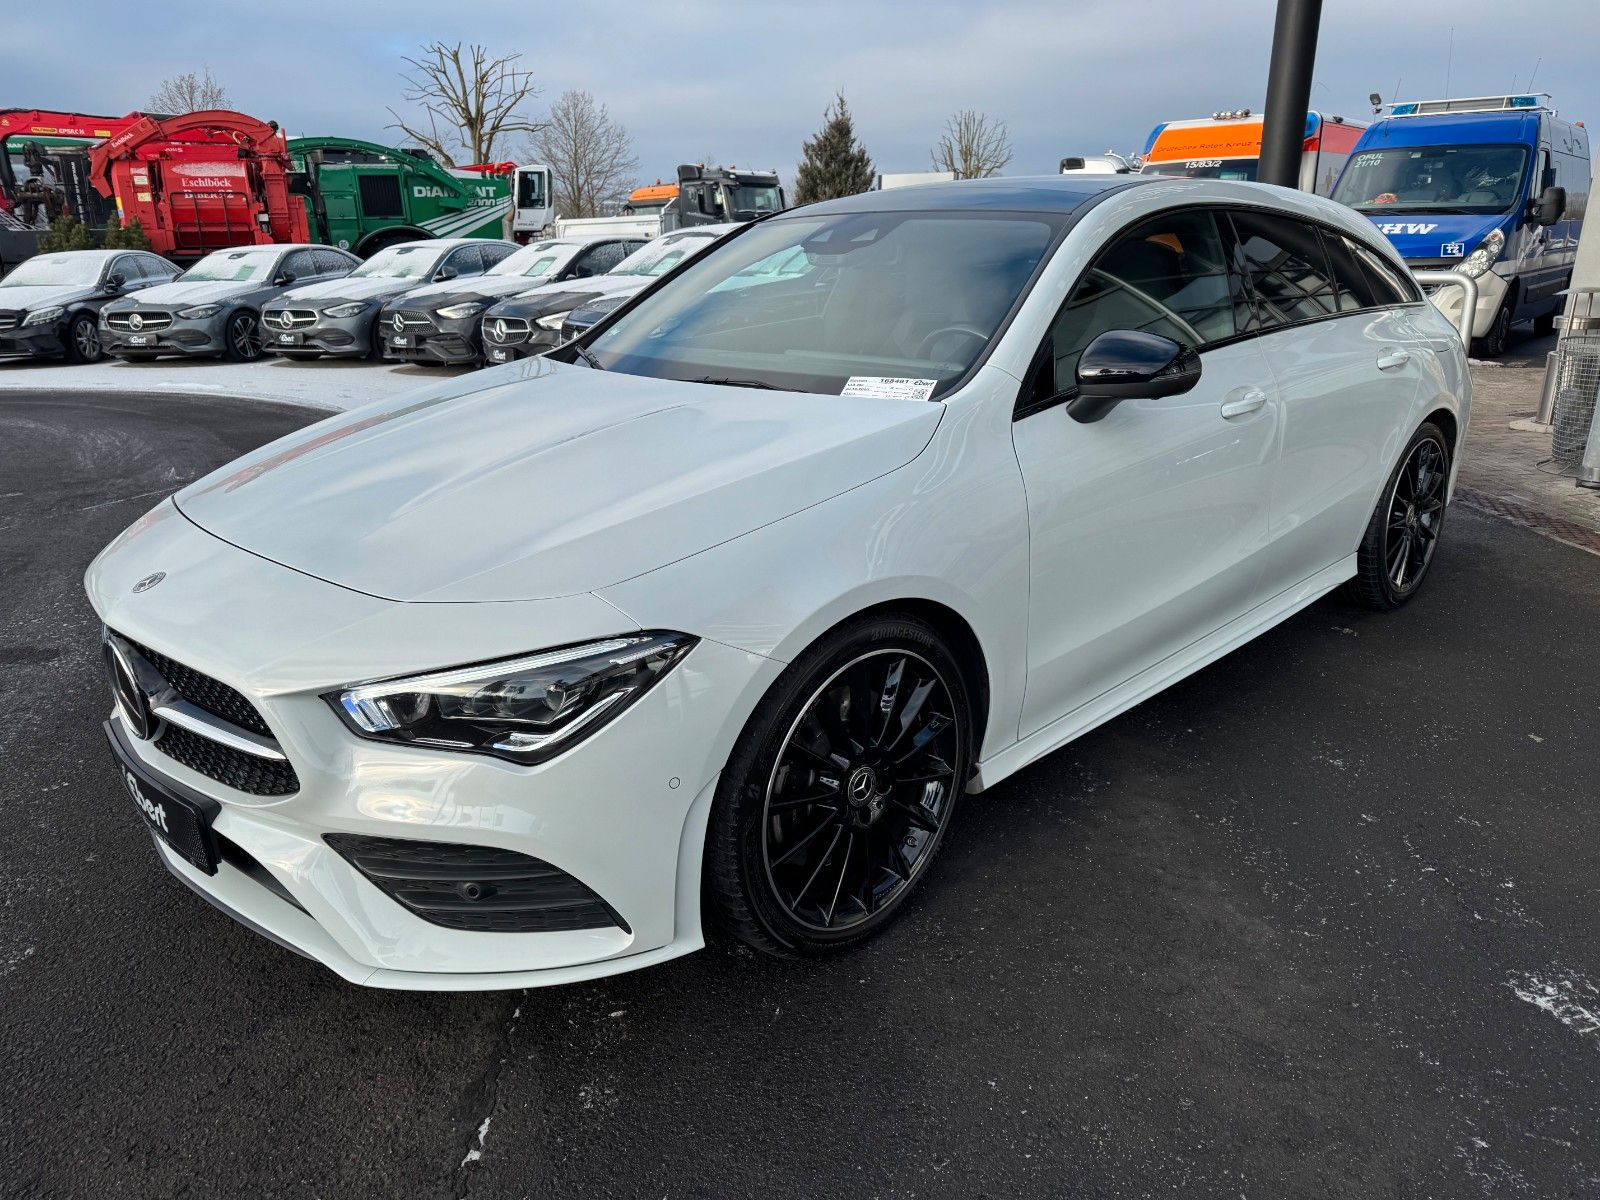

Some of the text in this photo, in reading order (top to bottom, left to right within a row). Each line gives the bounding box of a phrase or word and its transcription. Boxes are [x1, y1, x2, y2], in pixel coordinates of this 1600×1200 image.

[1185, 160, 1222, 169] 15/83/2
[1354, 160, 1381, 168] 21/10
[181, 178, 232, 187] Eschlböck
[1377, 223, 1439, 235] HW
[871, 625, 935, 648] BRIDGESTONE
